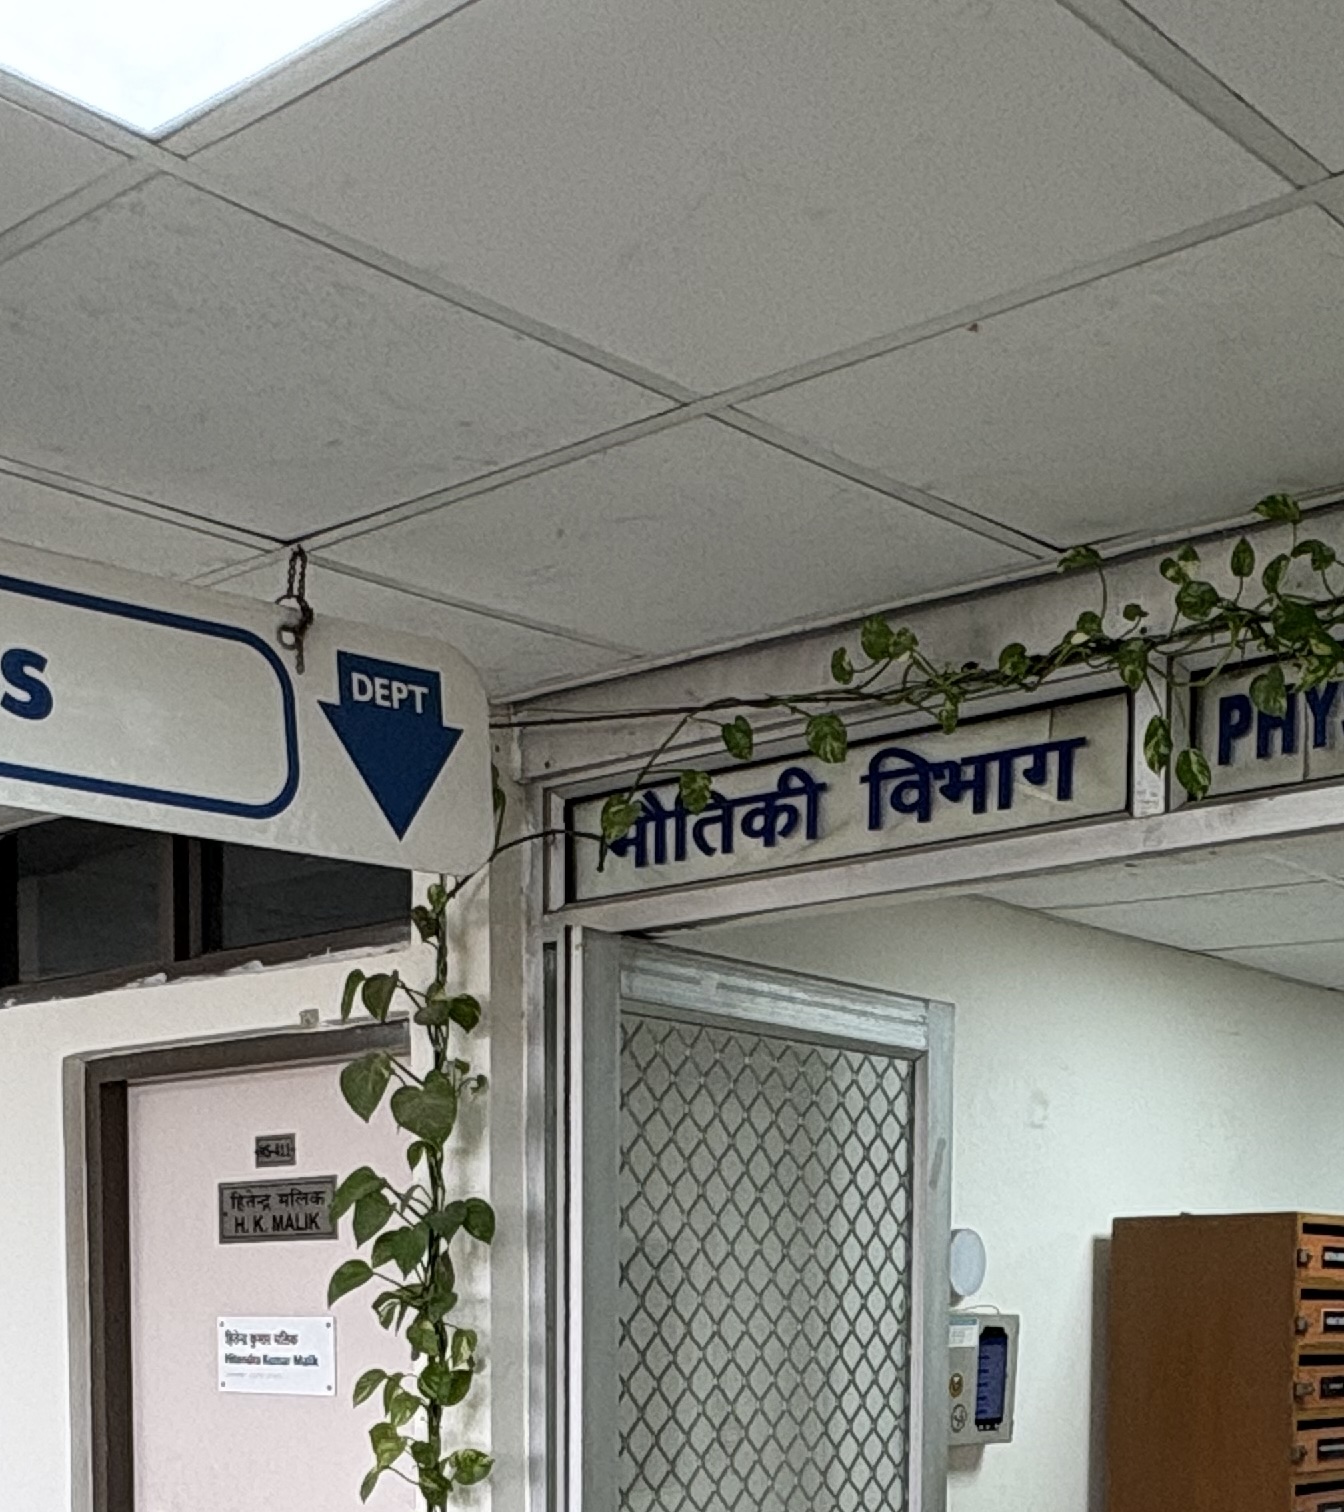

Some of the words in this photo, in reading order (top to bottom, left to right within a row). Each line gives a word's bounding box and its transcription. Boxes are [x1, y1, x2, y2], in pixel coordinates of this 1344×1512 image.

[351, 671, 430, 714] DEPT
[860, 737, 1087, 830] विभाग
[235, 1215, 250, 1233] H.
[272, 1212, 321, 1232] MALIK
